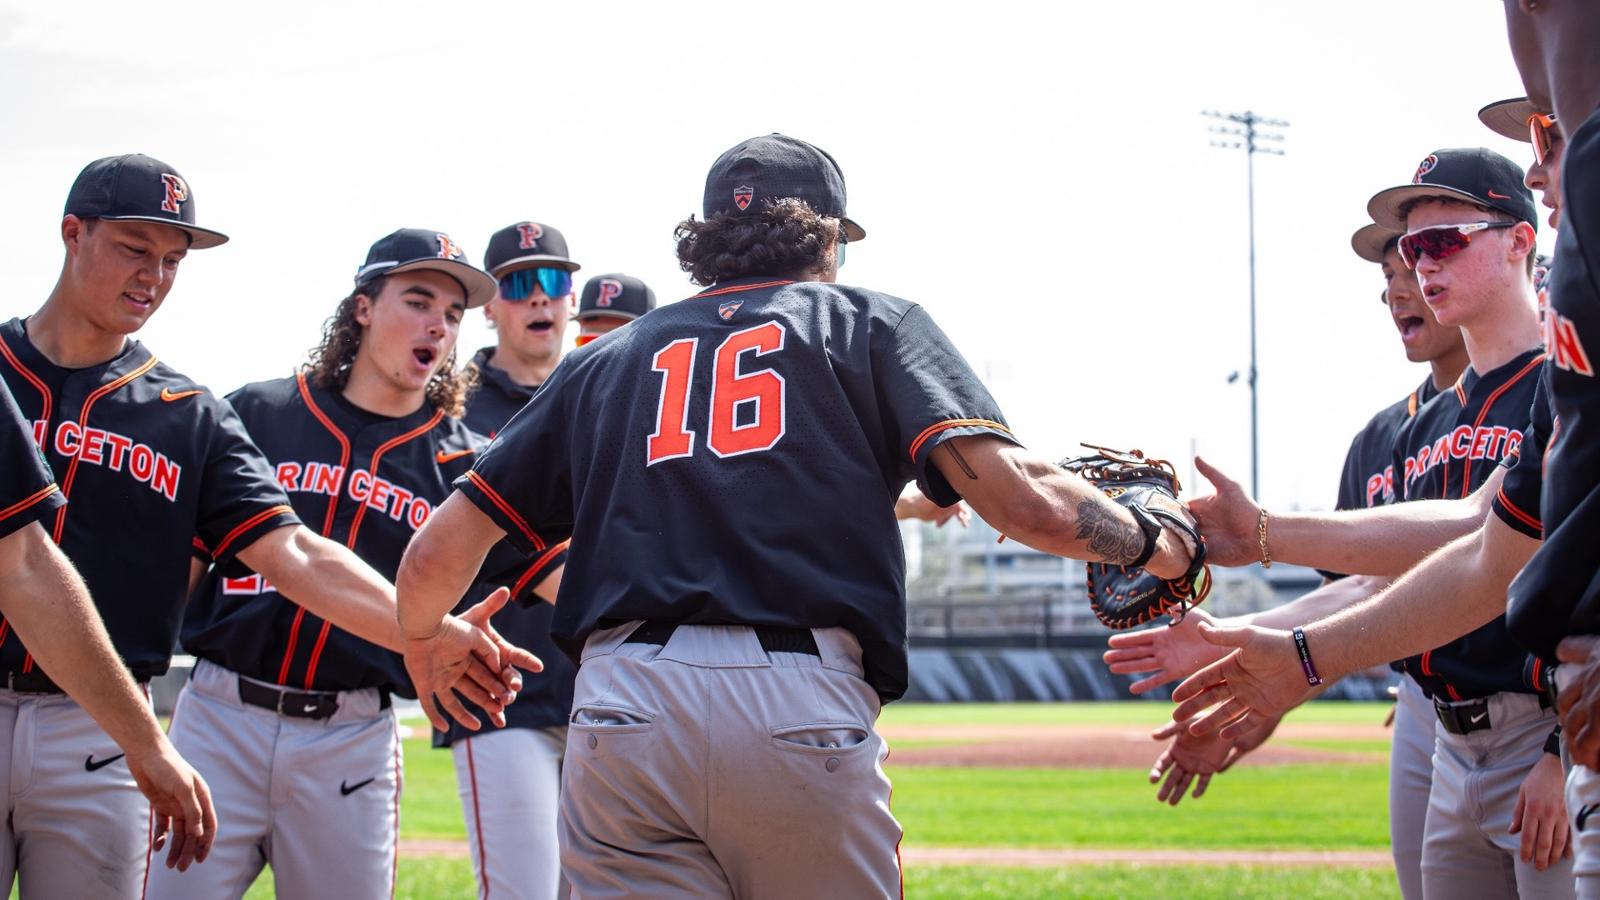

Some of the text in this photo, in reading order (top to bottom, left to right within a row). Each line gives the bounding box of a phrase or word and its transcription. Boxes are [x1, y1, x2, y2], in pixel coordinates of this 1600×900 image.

[1412, 155, 1438, 184] P
[161, 173, 188, 213] P
[436, 233, 462, 259] P
[517, 223, 542, 249] P
[596, 279, 622, 307] P
[647, 320, 786, 467] 16
[273, 462, 437, 530] RINCETO
